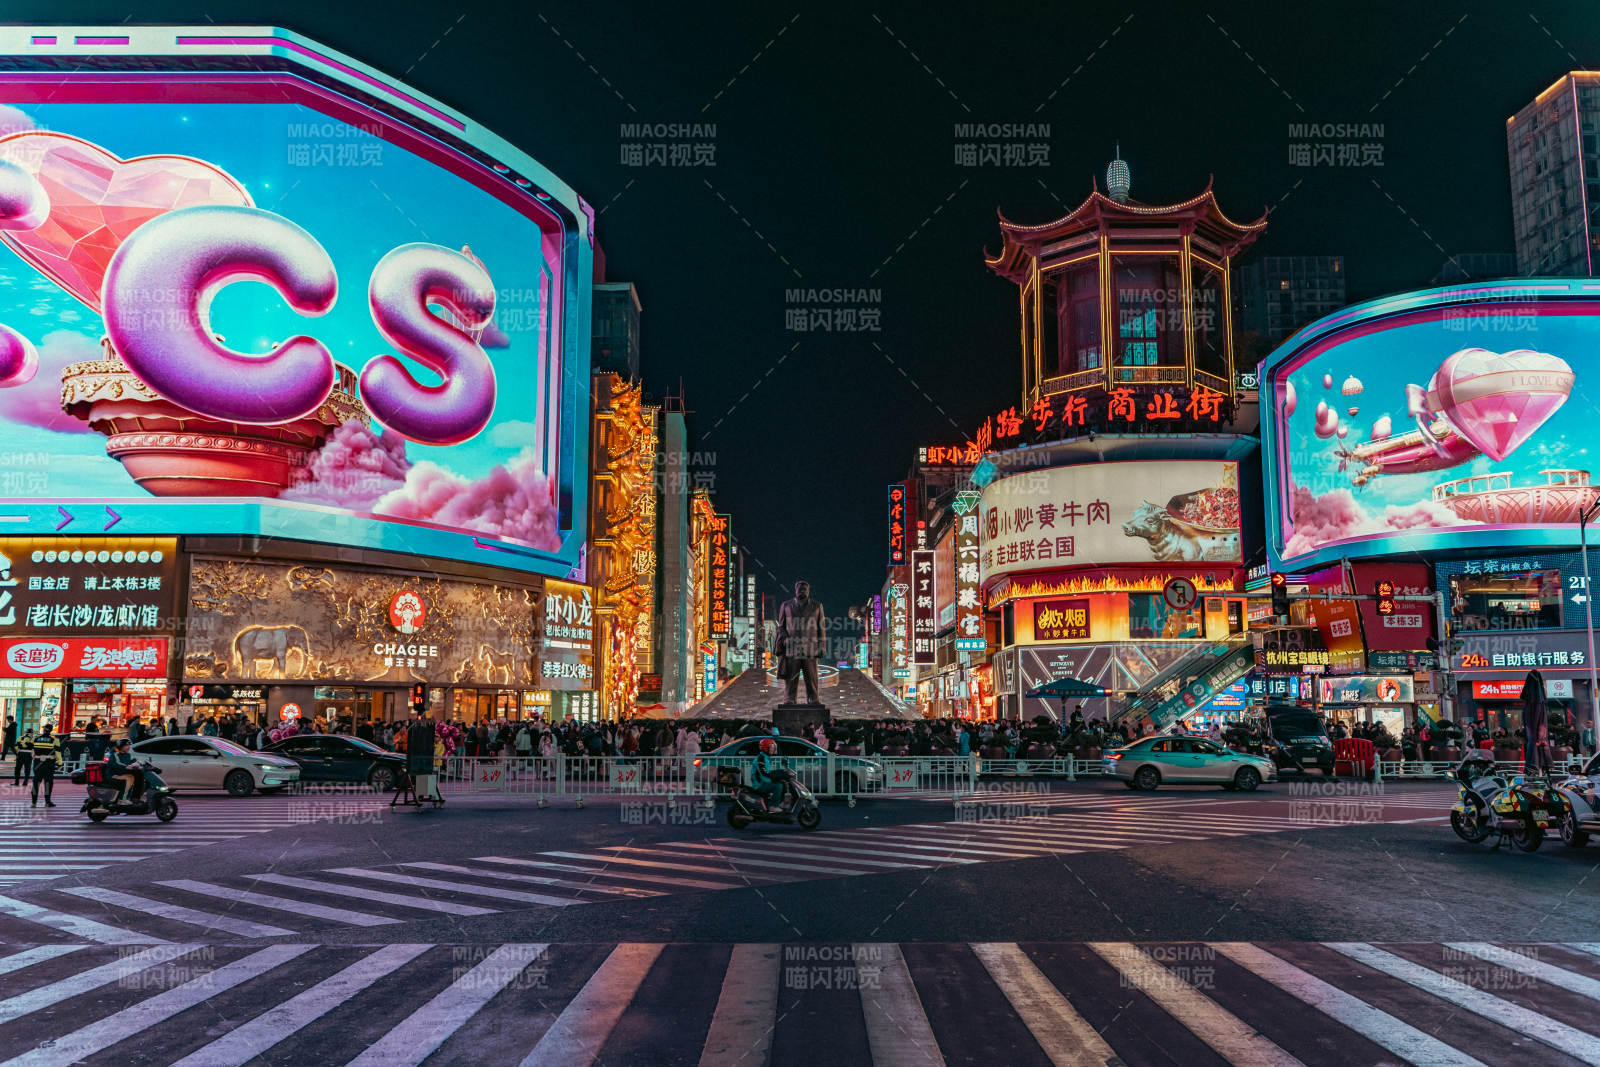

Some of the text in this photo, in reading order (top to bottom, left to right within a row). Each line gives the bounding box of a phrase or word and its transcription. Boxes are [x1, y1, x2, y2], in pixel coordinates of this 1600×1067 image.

[958, 515, 982, 636] 周六福珠宝
[28, 576, 161, 591] 国金店 请上本栋3楼
[545, 588, 593, 627] 虾小龙
[13, 648, 58, 663] 金磨坊
[373, 643, 438, 658] CHAGEE
[1266, 650, 1330, 665] 杭州宝岛眼镜
[1461, 651, 1586, 668] 24h 自助银行服务
[1480, 684, 1500, 694] 24h
